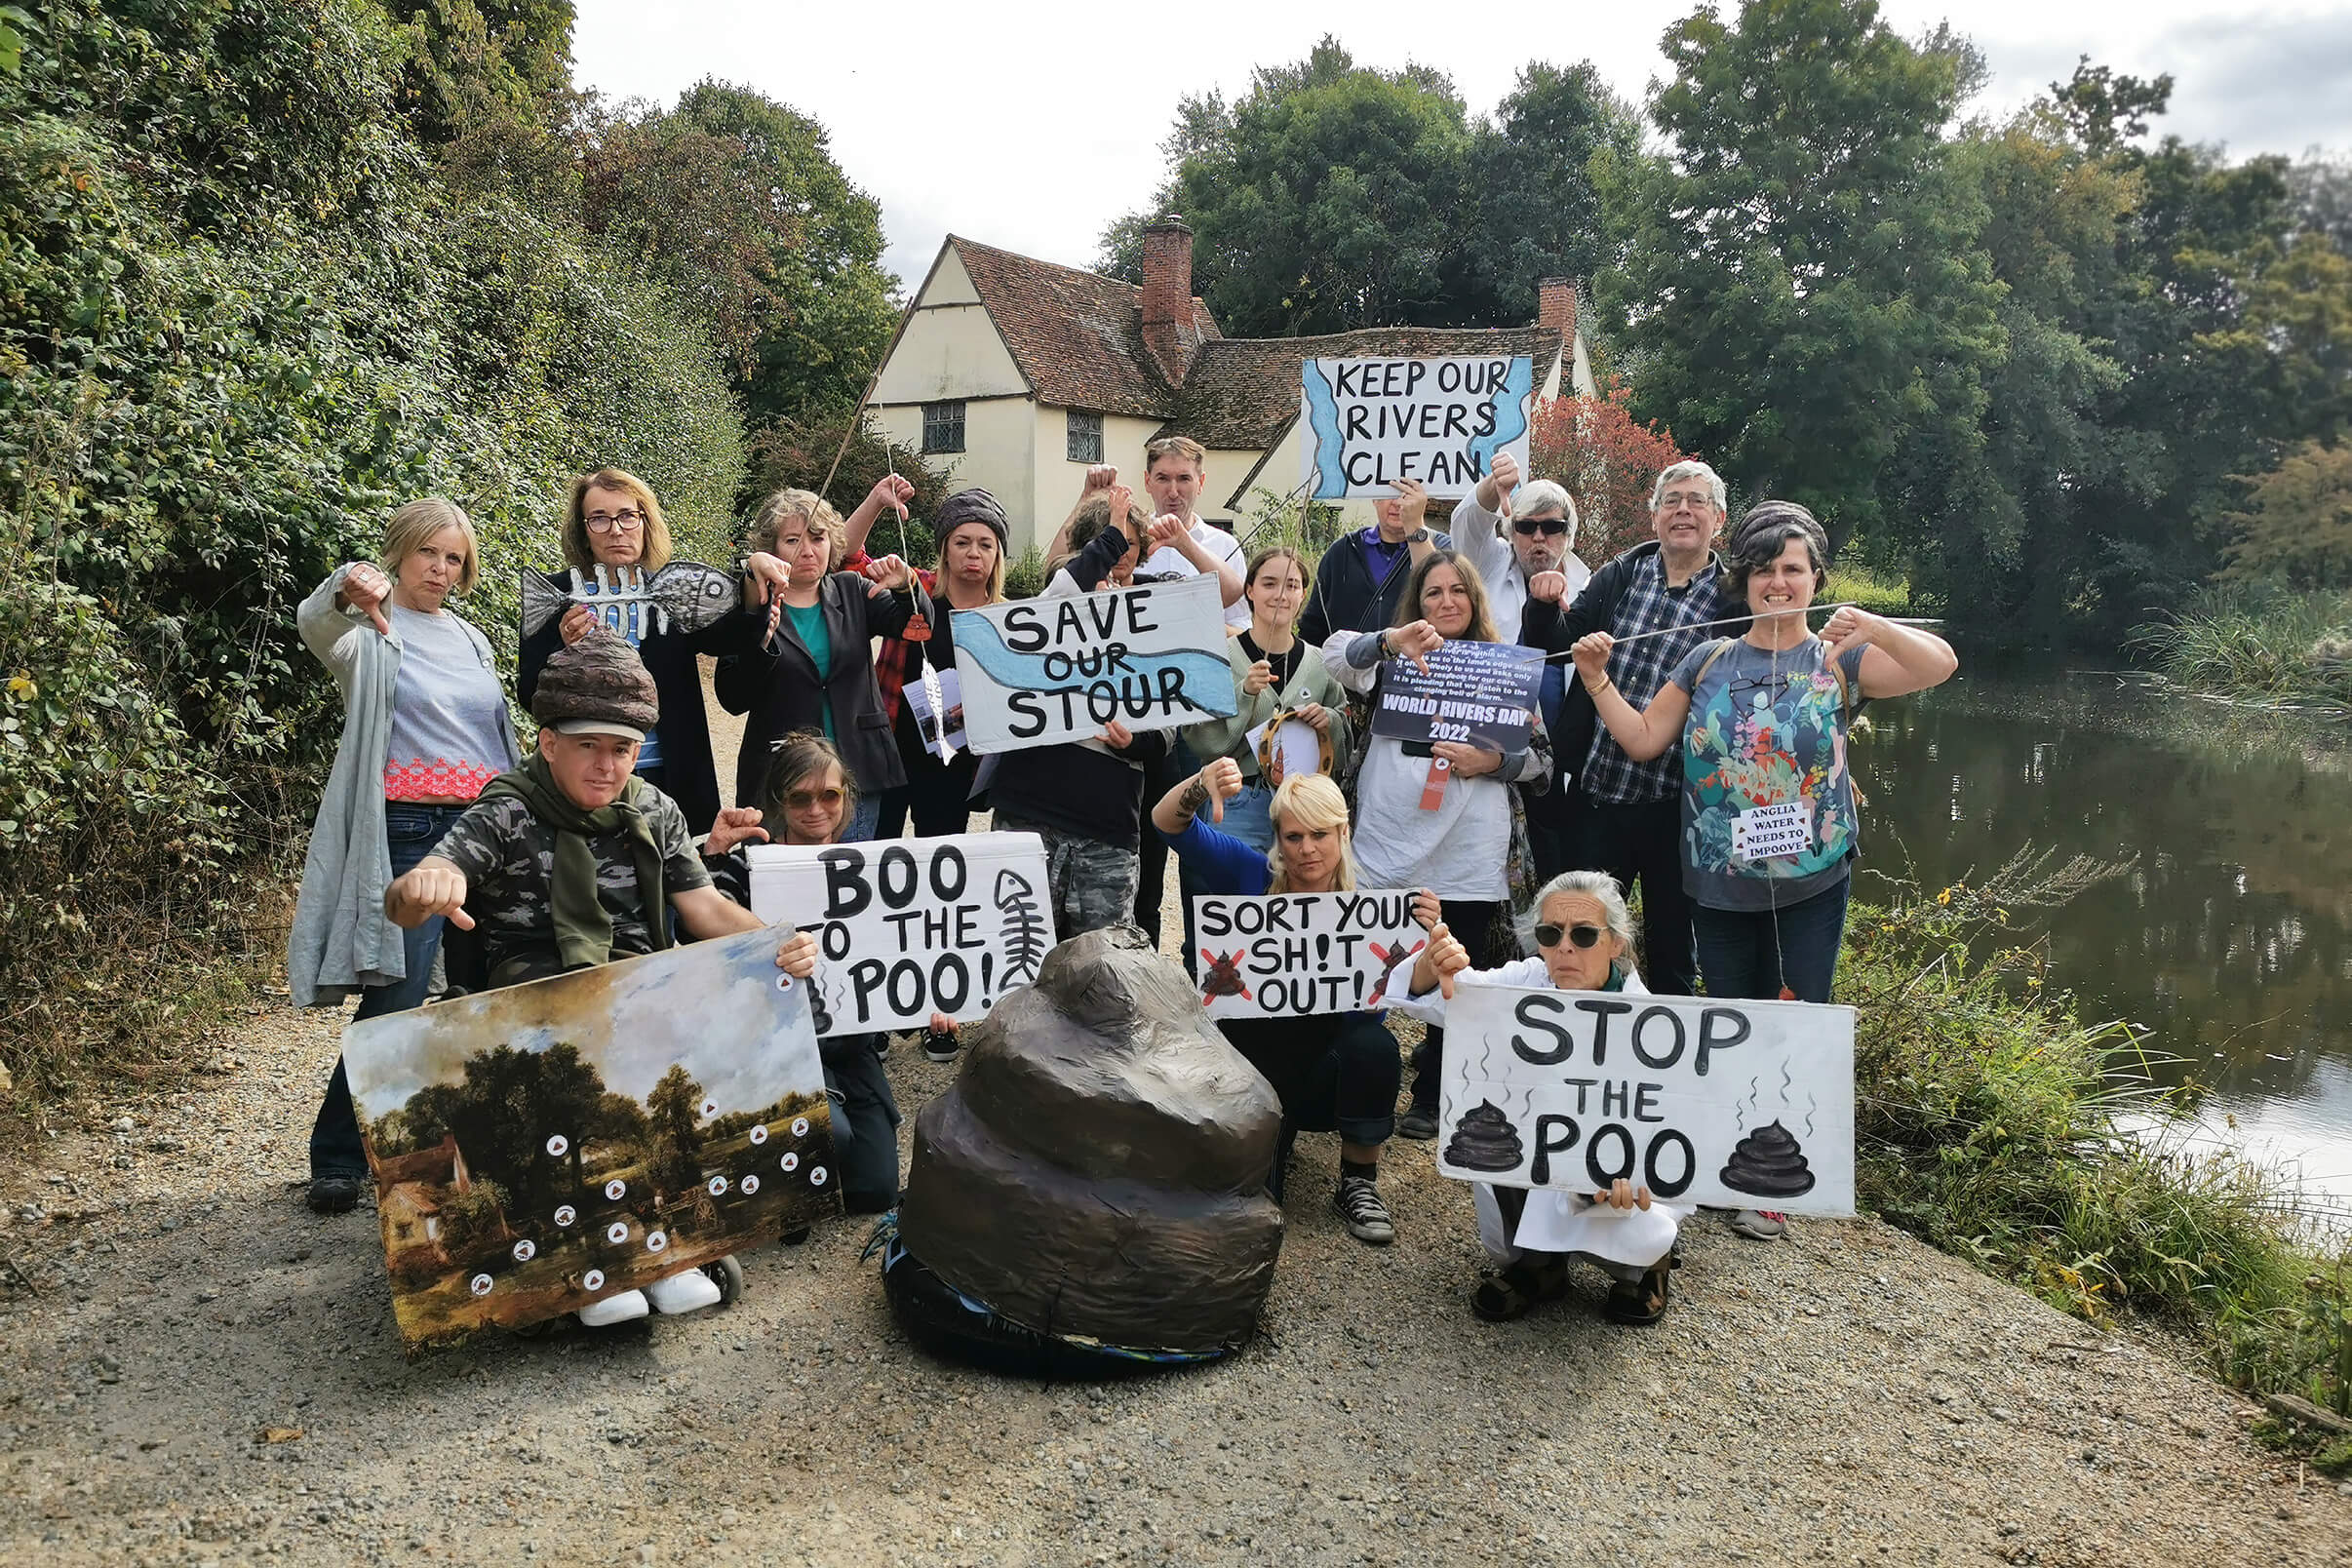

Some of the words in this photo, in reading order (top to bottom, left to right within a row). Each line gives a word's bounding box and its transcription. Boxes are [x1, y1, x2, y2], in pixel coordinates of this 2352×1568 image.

[1337, 363, 1426, 397] KEEP
[1438, 361, 1509, 394] OUR
[1347, 402, 1498, 439] RIVERS
[1347, 451, 1480, 486] CLEAN
[1004, 589, 1158, 651] SAVE
[1043, 642, 1136, 681] OUR
[1513, 673, 1532, 682] only
[1410, 677, 1444, 687] pleading
[1446, 680, 1463, 688] that
[1478, 684, 1502, 692] listen
[1413, 686, 1447, 695] clanging
[1497, 678, 1518, 686] care.
[1007, 667, 1193, 738] STOUR
[1382, 693, 1437, 716] WORLD
[1438, 700, 1496, 724] RIVERS
[1497, 709, 1529, 726] DAY
[1428, 722, 1470, 742] 2022
[1751, 805, 1796, 818] ANGLIA
[1755, 817, 1794, 831] WATER
[1746, 832, 1785, 844] NEEDS
[1788, 829, 1804, 839] TO
[1749, 842, 1802, 857] IMPOOVE
[817, 844, 966, 920] BOO
[882, 905, 986, 952] THE
[1200, 896, 1320, 936] SORT
[1335, 891, 1430, 932] YOUR
[1247, 933, 1364, 974] SH!T
[846, 952, 994, 1024] POO!
[1258, 970, 1365, 1013] OUT!
[1510, 995, 1751, 1077] STOP
[1563, 1078, 1666, 1122] THE
[1530, 1114, 1696, 1198] POO
